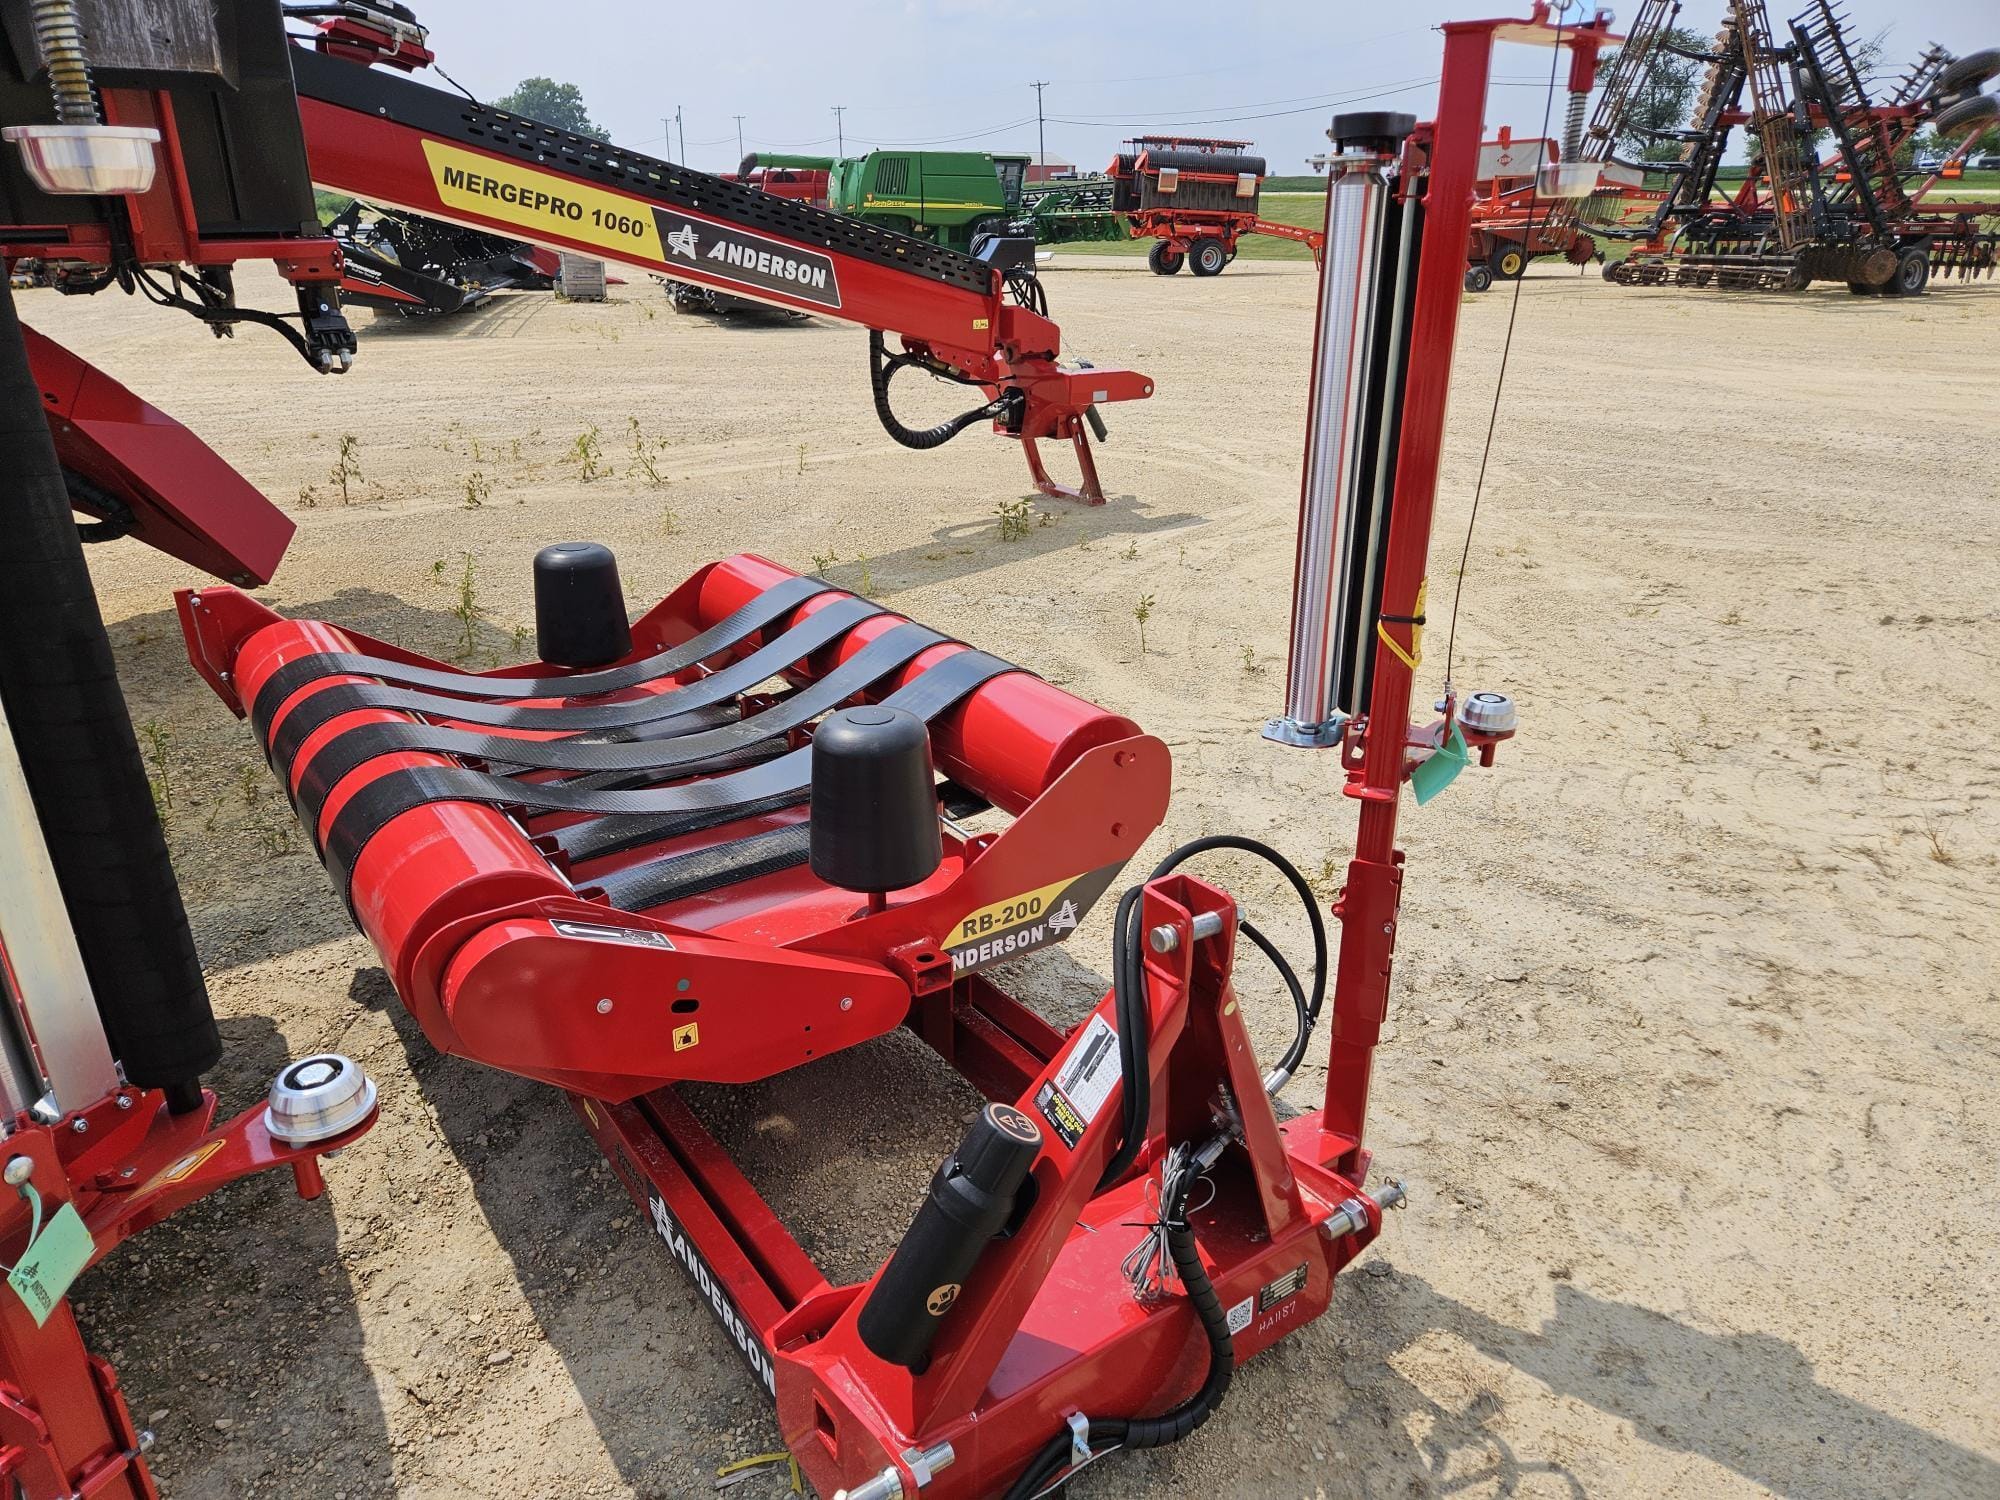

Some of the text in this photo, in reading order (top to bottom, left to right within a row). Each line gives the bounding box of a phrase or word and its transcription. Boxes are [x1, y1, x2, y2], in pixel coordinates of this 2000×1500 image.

[443, 166, 644, 237] MERGEPRO 1060
[708, 241, 826, 289] ANDERSON
[962, 897, 1042, 939] RB-200
[952, 924, 1044, 972] NDERSON
[1052, 1094, 1075, 1123] DOWNLOAD
[1073, 1121, 1084, 1134] OUR
[1055, 1106, 1067, 1121] FREE
[1065, 1119, 1075, 1131] APP
[674, 1234, 776, 1398] ANDERSON
